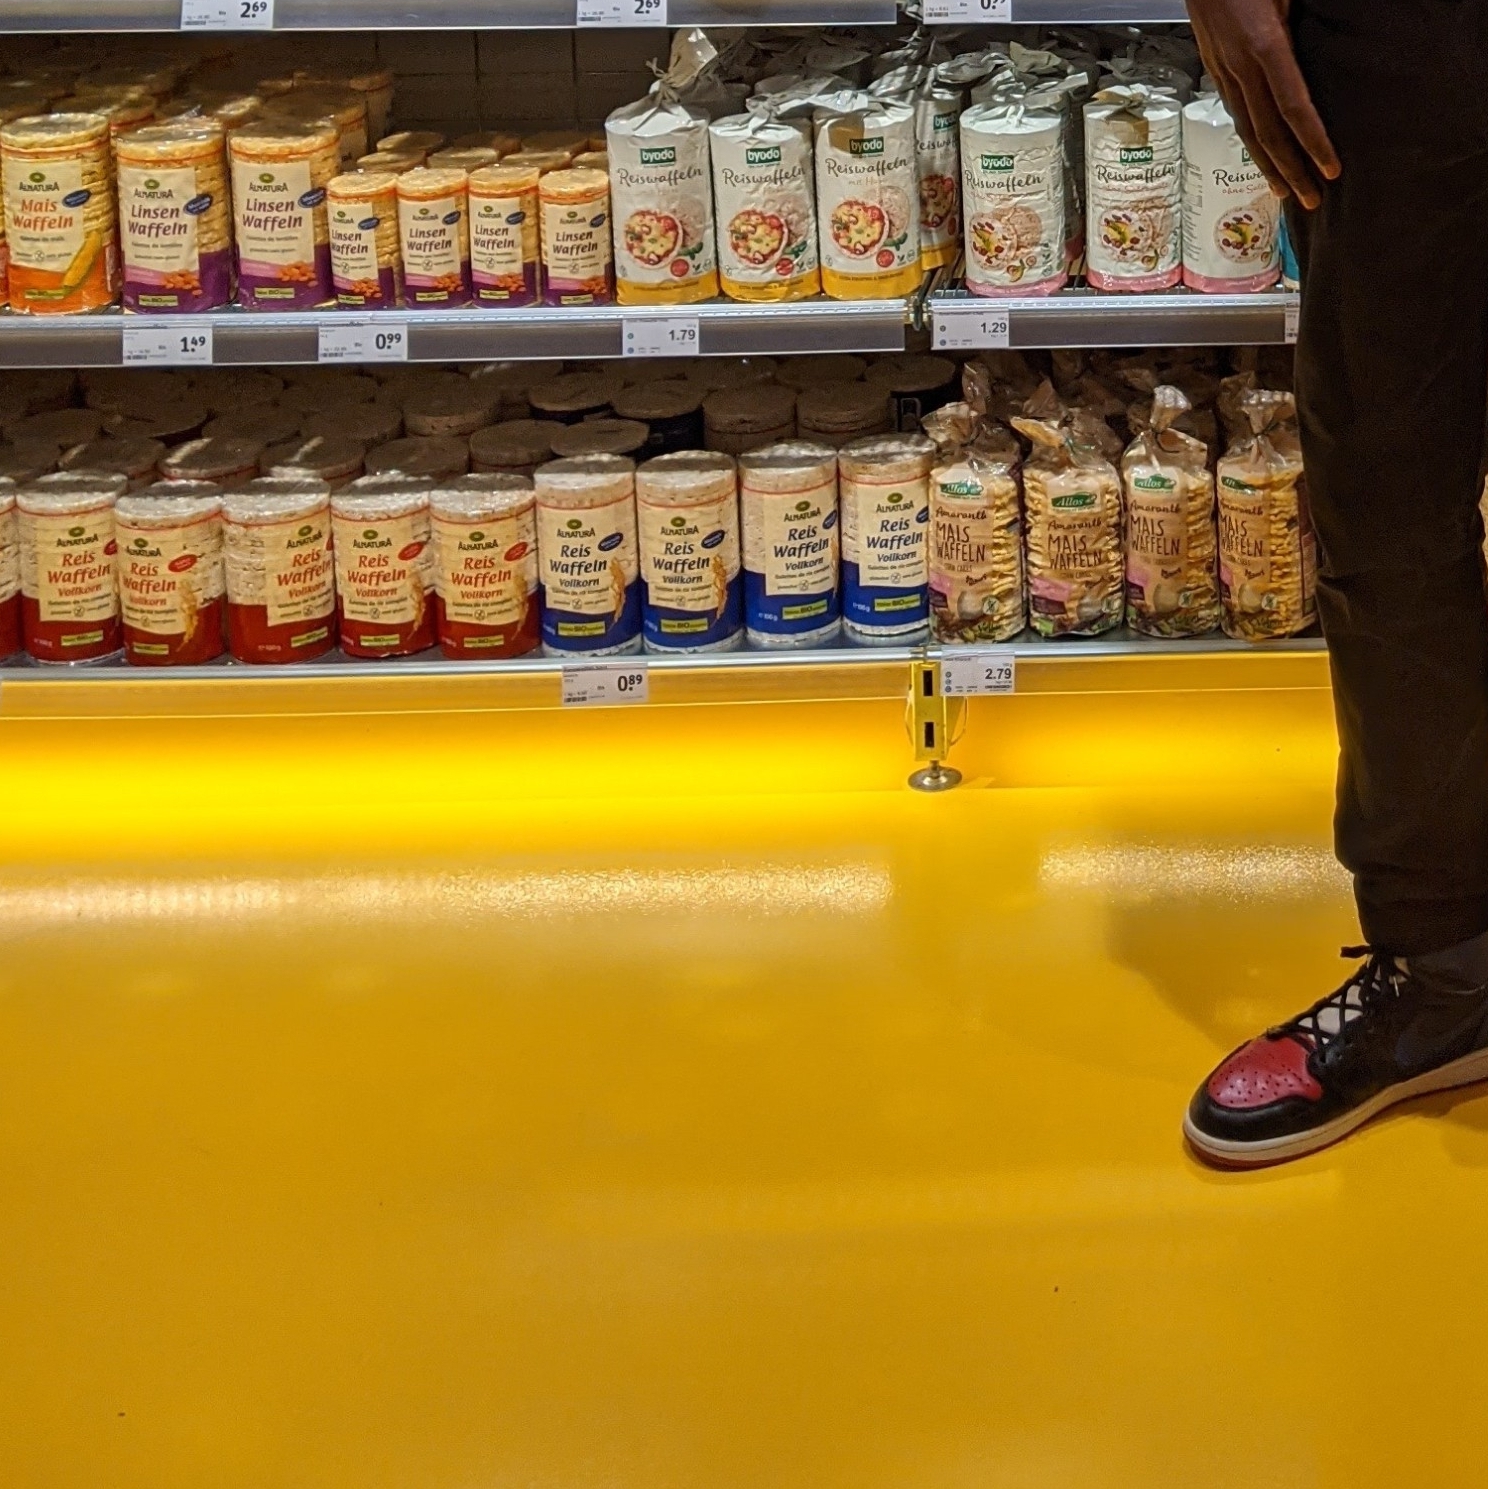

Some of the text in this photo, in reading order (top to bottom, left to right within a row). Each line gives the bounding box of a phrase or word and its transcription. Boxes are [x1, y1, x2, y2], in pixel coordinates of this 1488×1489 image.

[642, 148, 675, 161] byodo
[617, 166, 702, 186] Reiswaffeln
[21, 200, 57, 212] Mais
[131, 205, 179, 218] Linsen
[13, 215, 73, 229] Waffeln
[128, 221, 188, 237] Waffeln
[410, 227, 446, 238] Linsen
[980, 322, 1007, 334] 1.29
[669, 329, 696, 341] 1.79
[661, 526, 699, 535] ALNATURA
[936, 525, 970, 542] MAIS
[560, 545, 591, 557] Reis
[664, 542, 694, 554] Reis
[936, 545, 985, 562] WAFFELN
[358, 555, 388, 567] Reis
[550, 559, 607, 574] Waffeln
[653, 556, 710, 572] Waffeln
[347, 569, 406, 583] Waffeln
[663, 575, 703, 584] Vollkorn
[356, 587, 397, 598] Vollkorn
[985, 668, 1012, 679] 2.79
